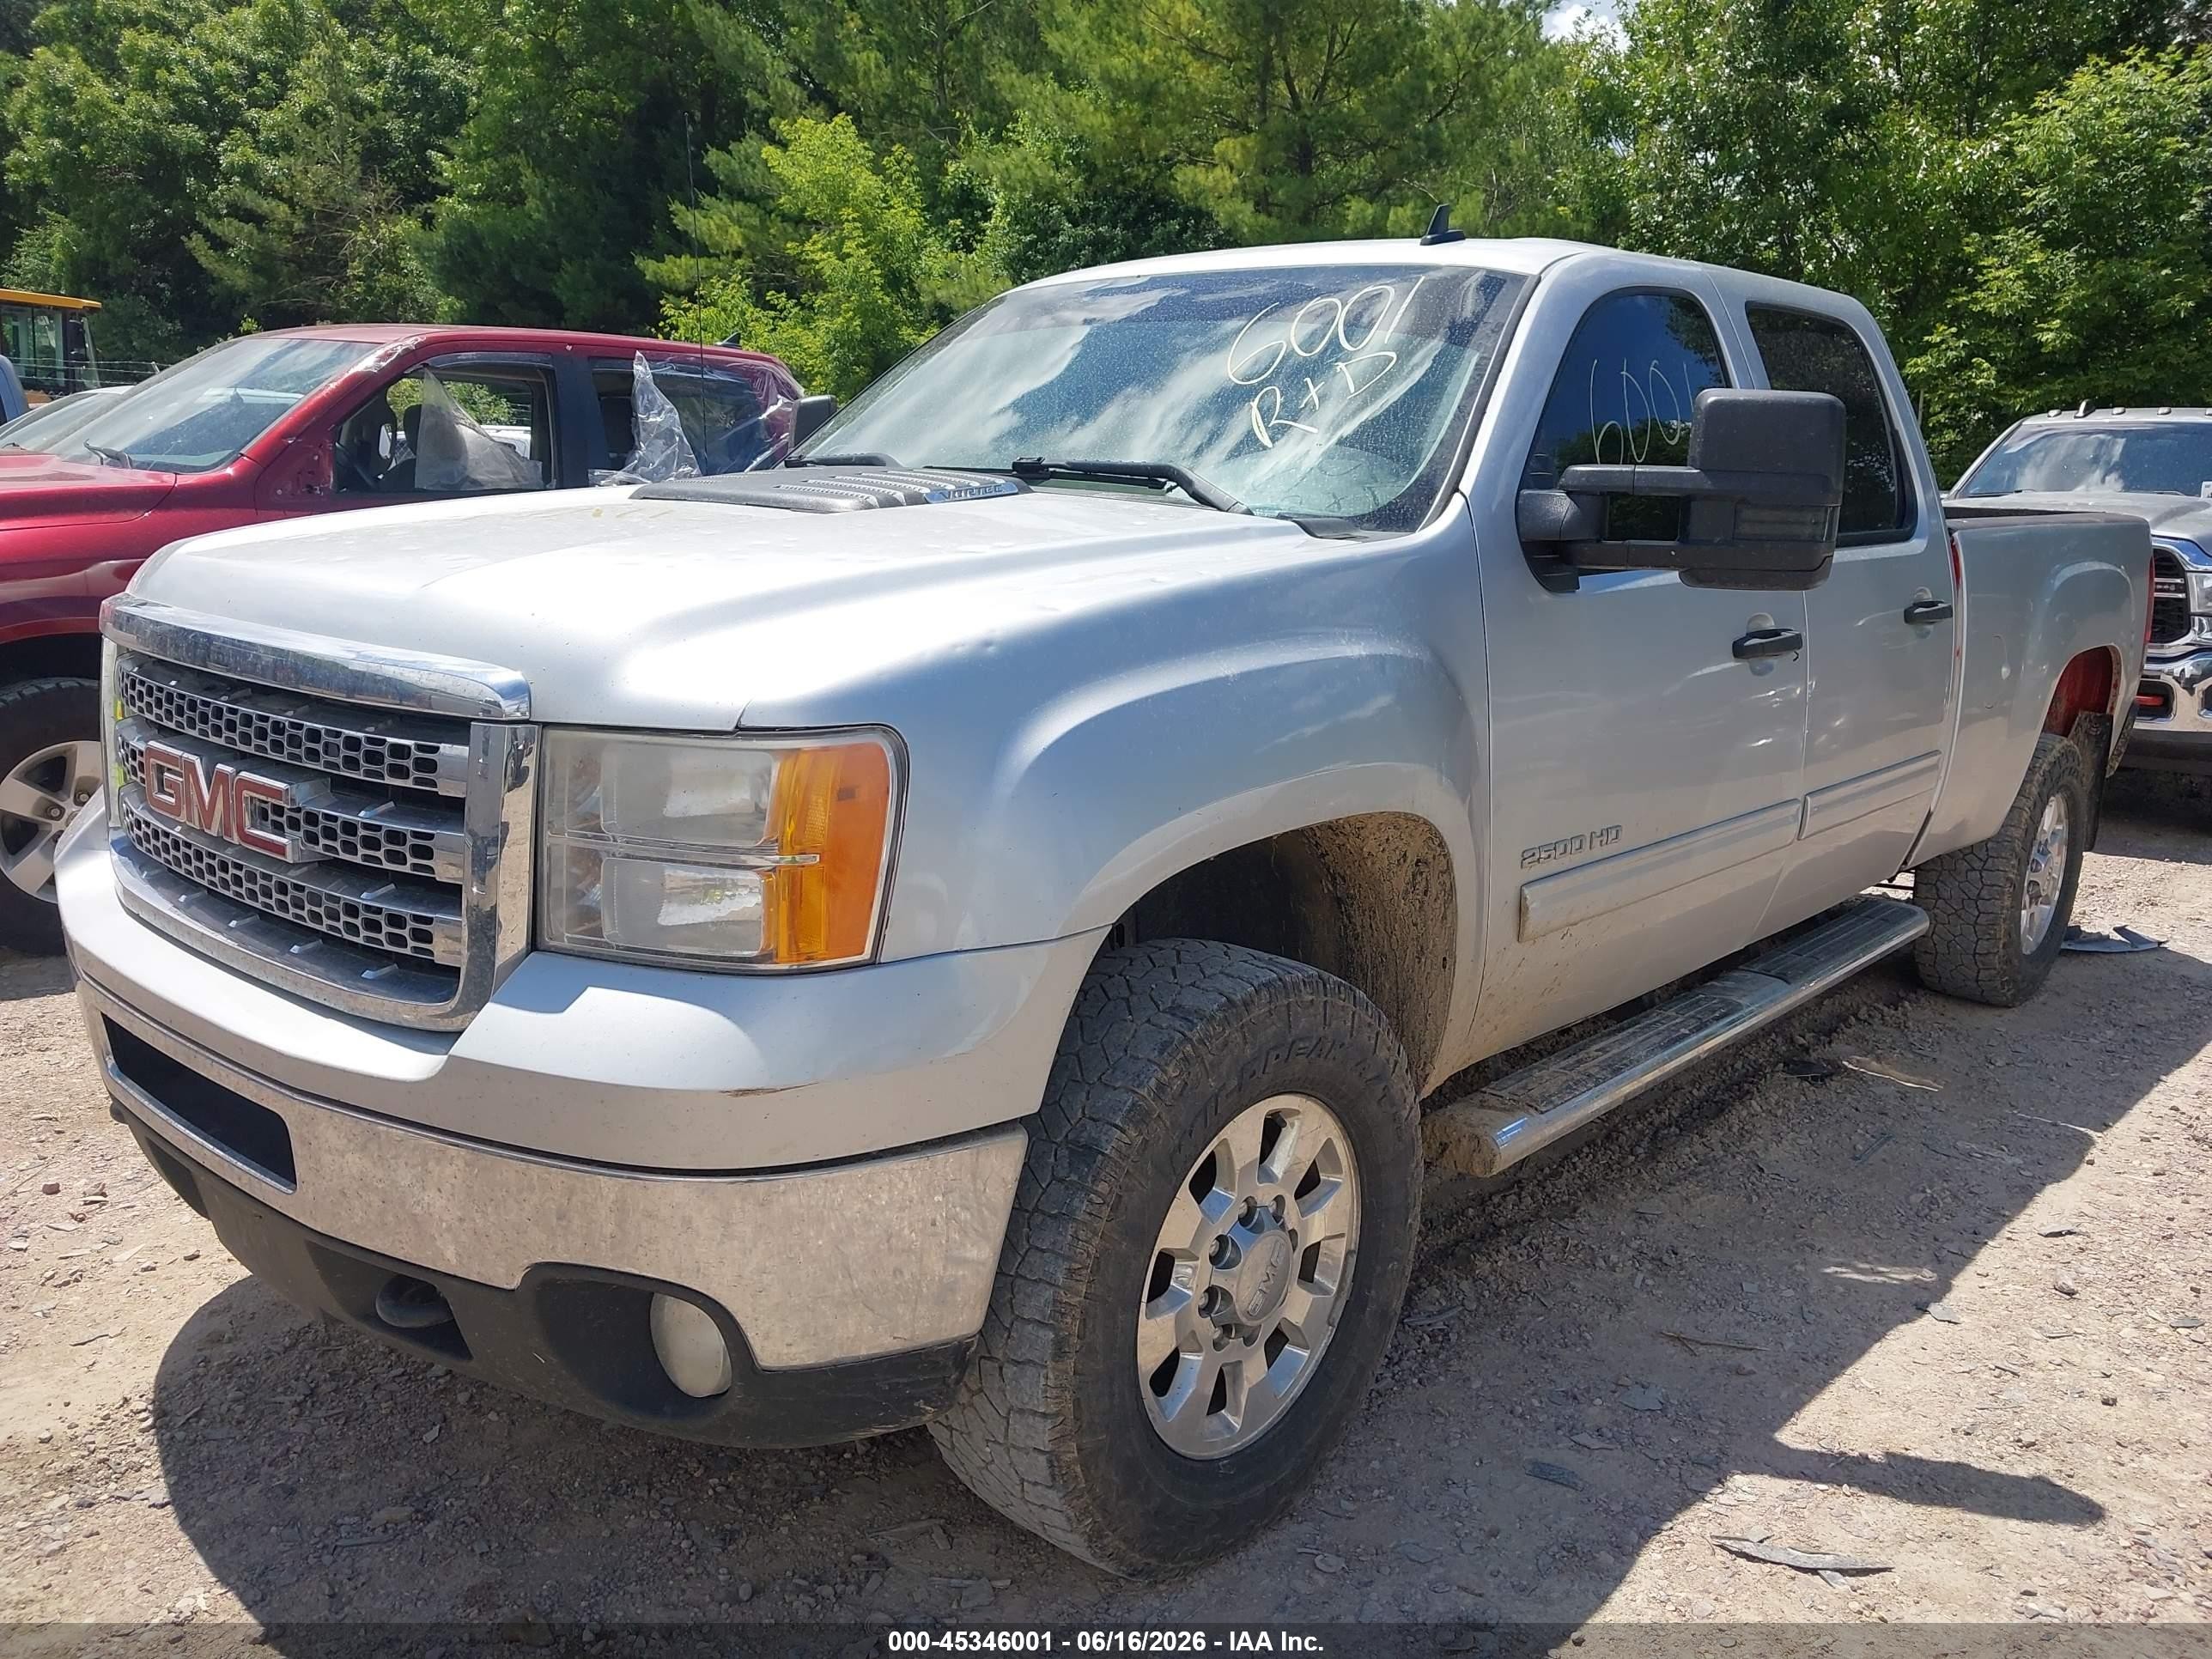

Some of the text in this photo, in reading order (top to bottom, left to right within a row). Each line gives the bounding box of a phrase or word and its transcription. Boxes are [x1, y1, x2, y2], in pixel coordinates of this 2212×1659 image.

[1227, 275, 1425, 386] 6001
[144, 740, 301, 864] GMC
[1520, 824, 1623, 870] 2500 HD
[1247, 1235, 1285, 1316] GMC
